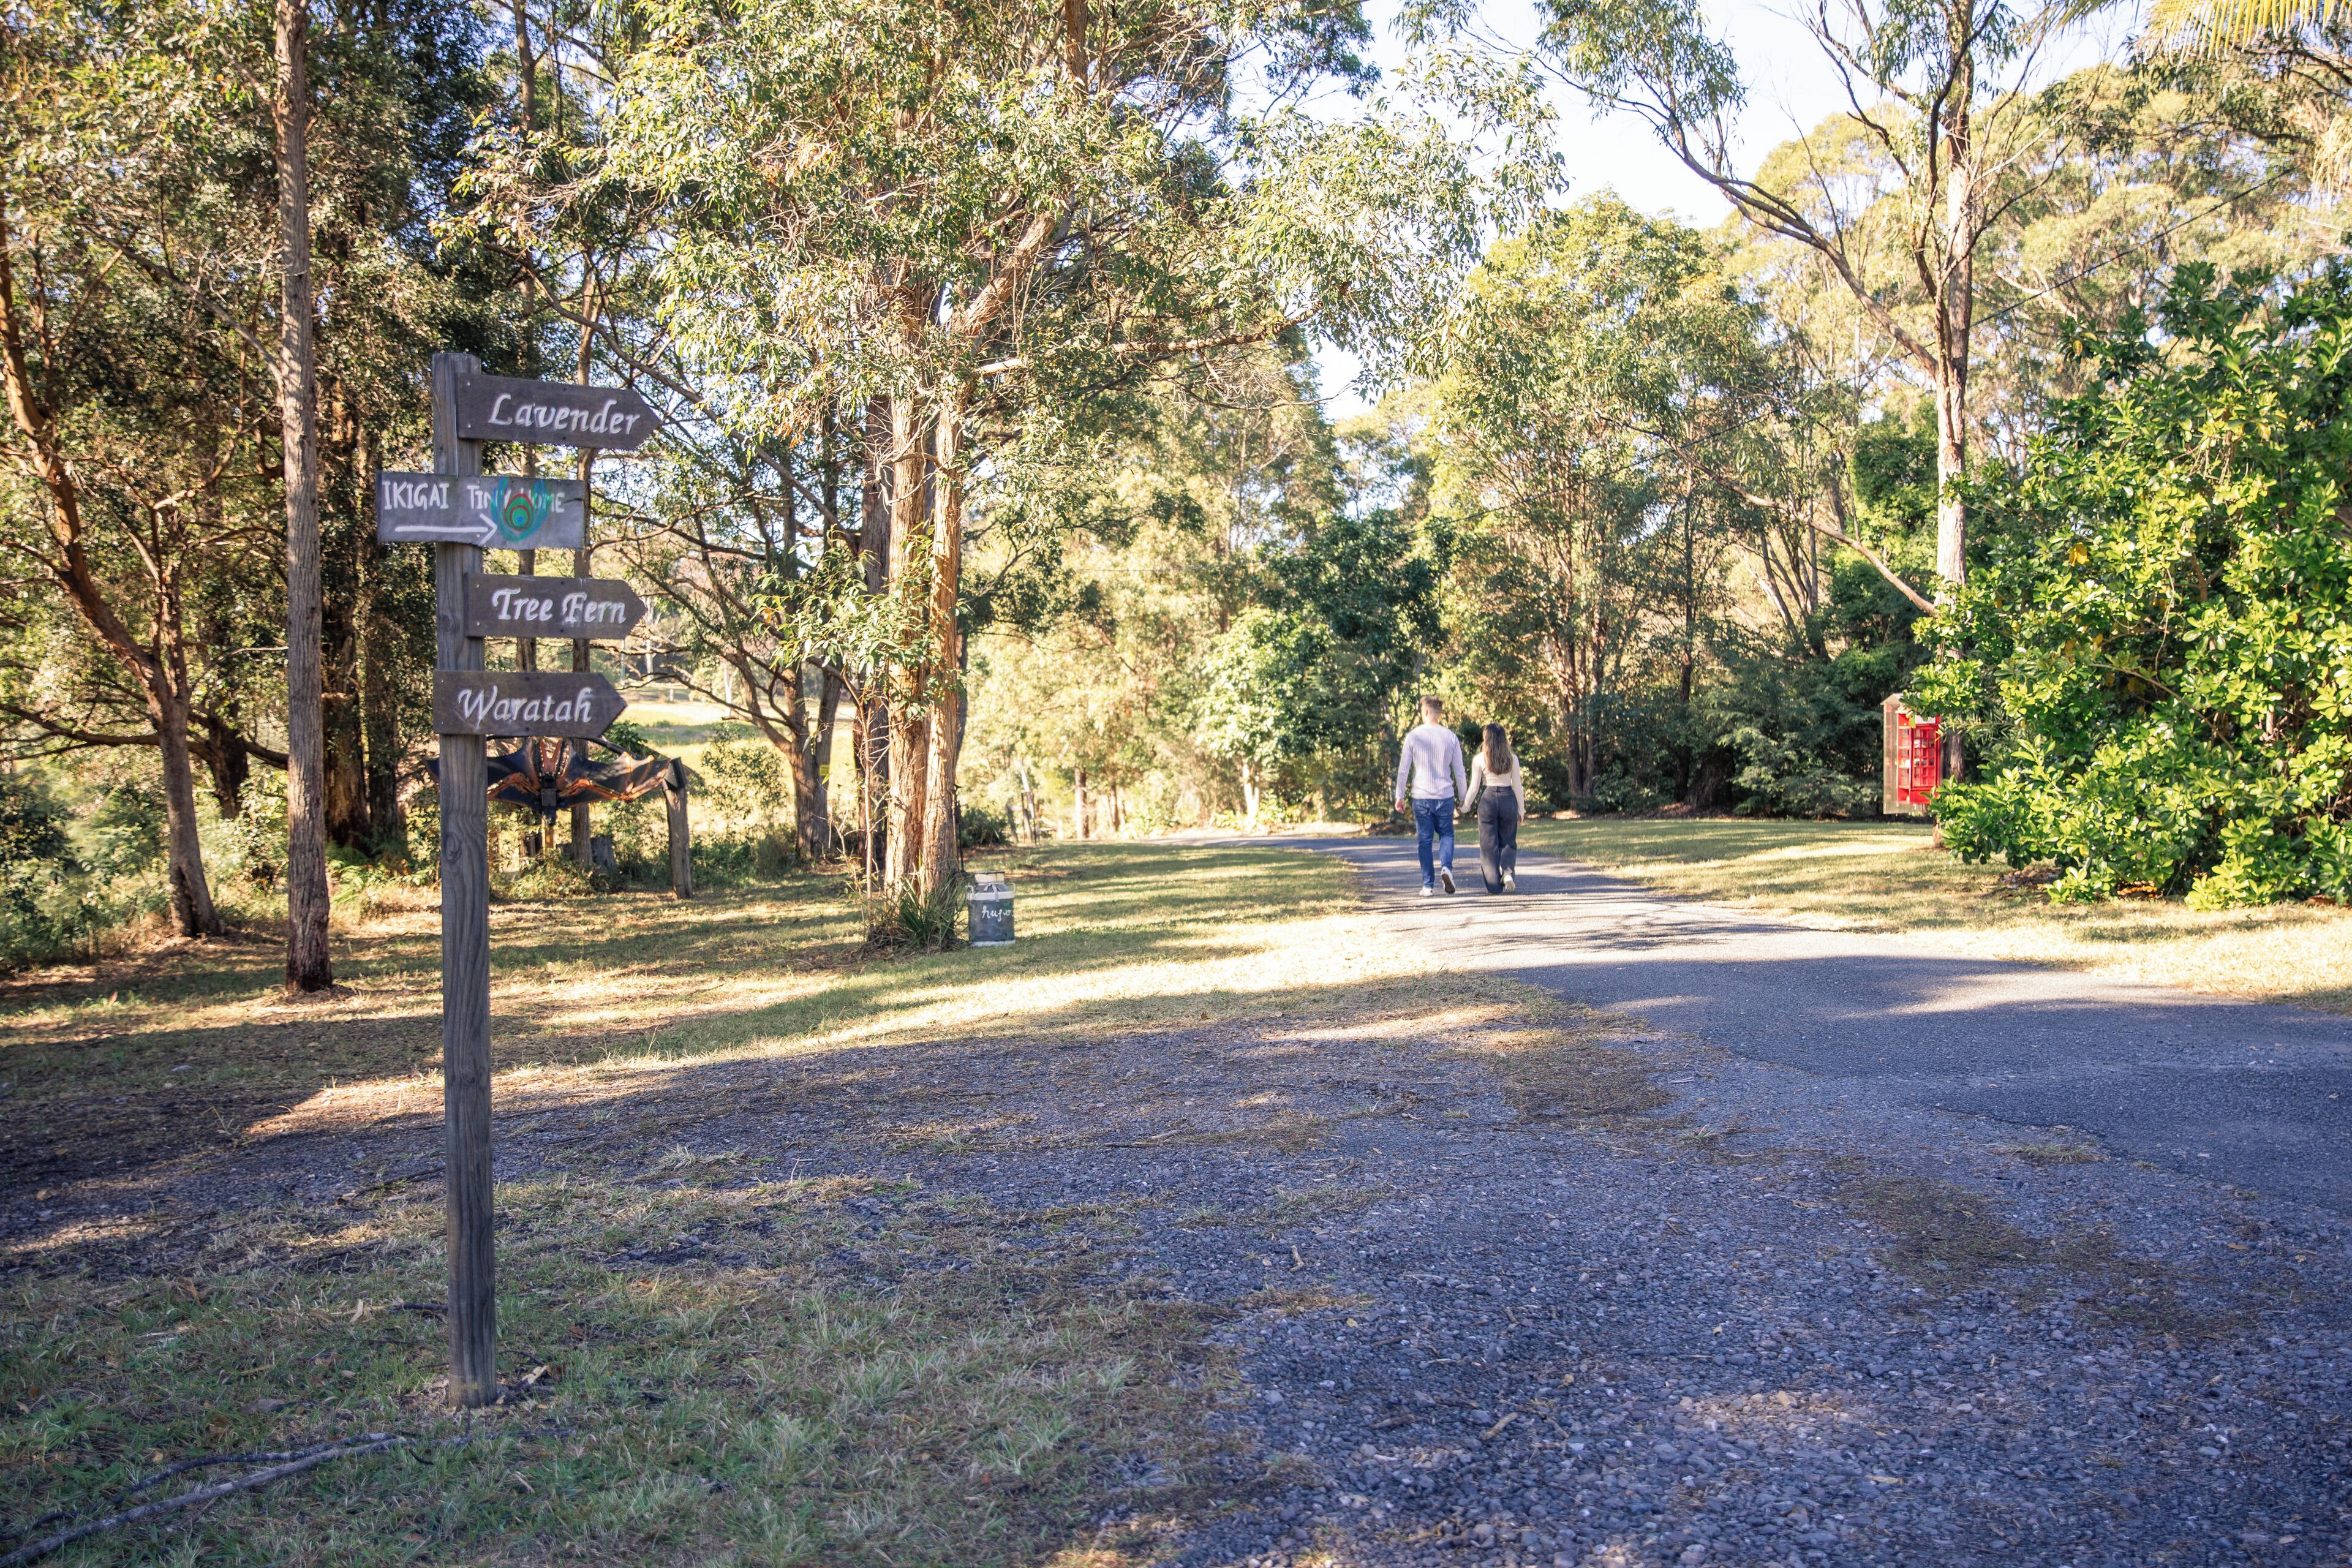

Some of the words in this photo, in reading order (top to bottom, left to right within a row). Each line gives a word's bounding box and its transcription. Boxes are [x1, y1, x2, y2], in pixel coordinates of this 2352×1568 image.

[488, 393, 640, 435] Lavender
[382, 481, 450, 510] IKIGAI
[521, 488, 565, 513] OME
[492, 587, 553, 620] Tree
[562, 592, 627, 626] Fern
[458, 685, 592, 730] Waratah
